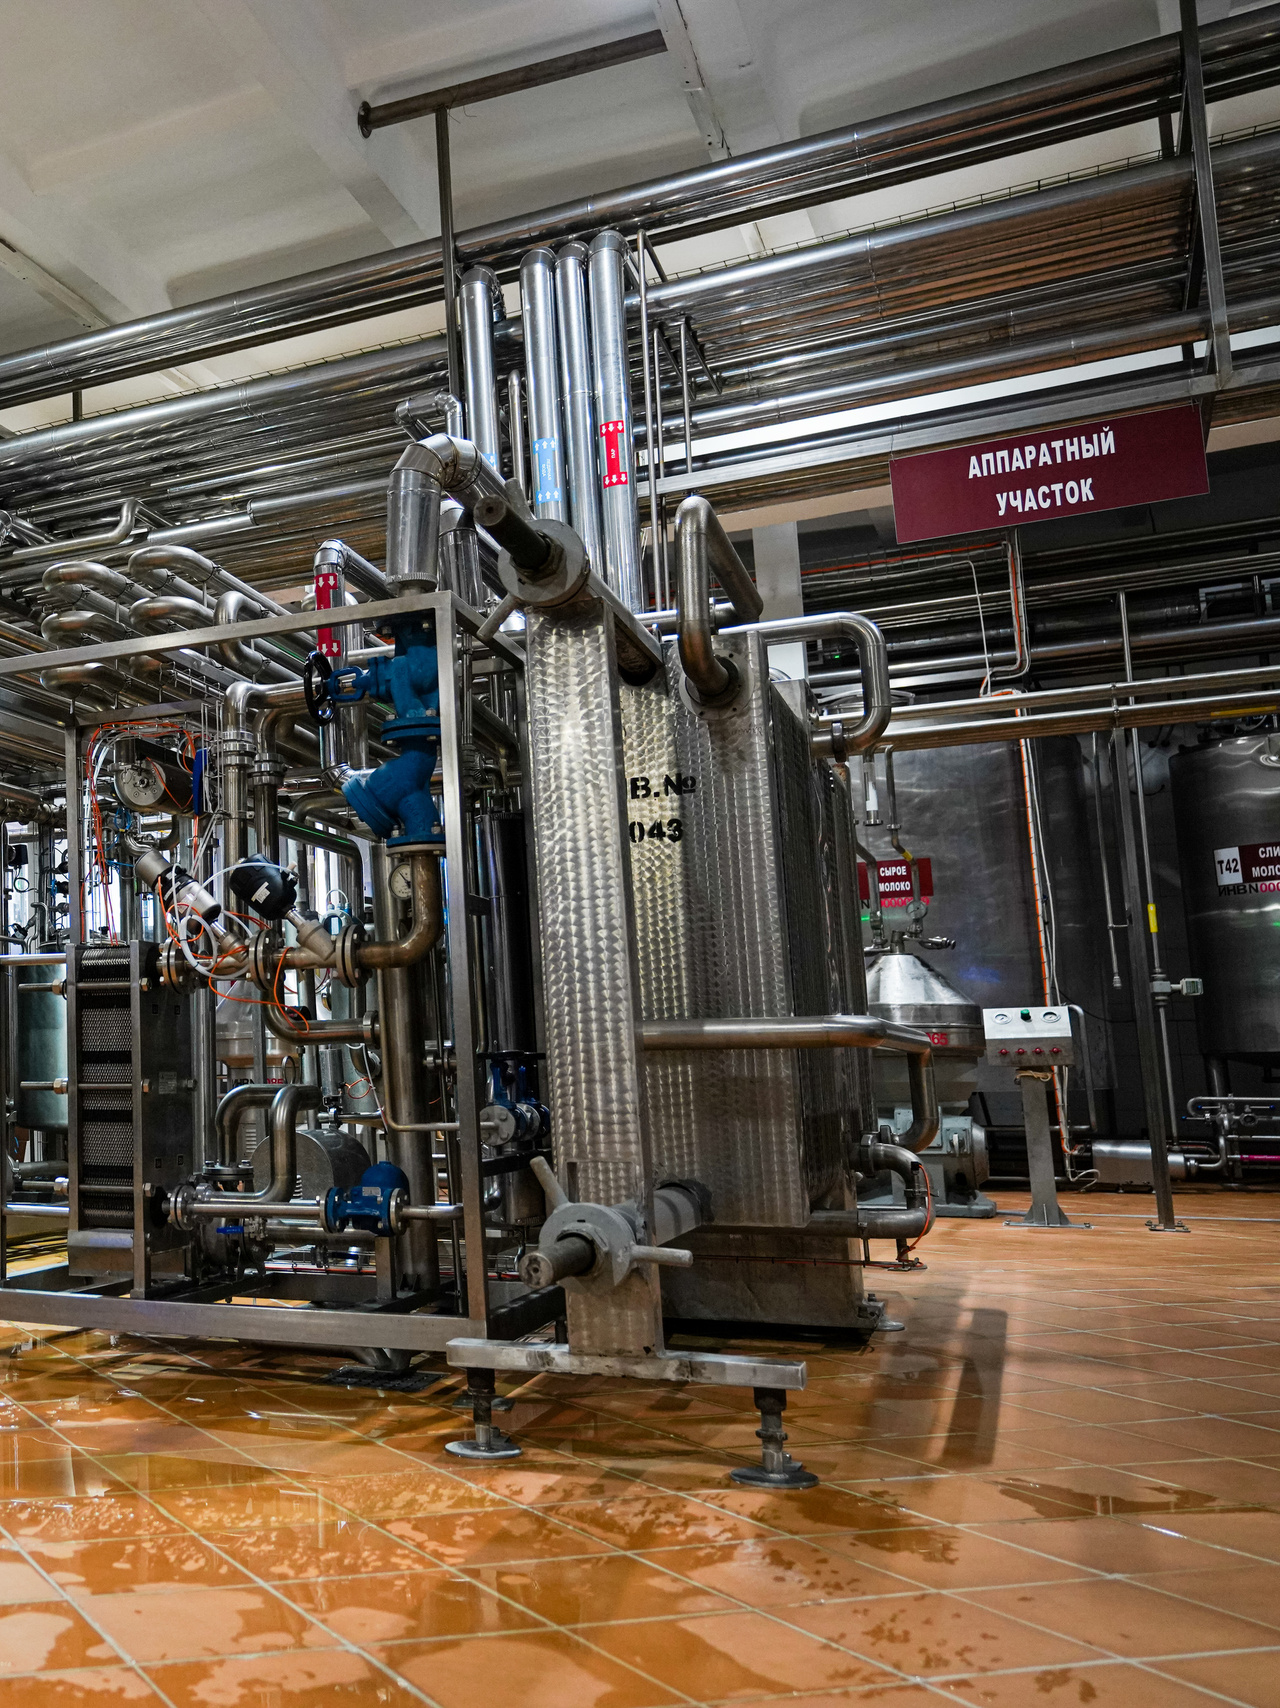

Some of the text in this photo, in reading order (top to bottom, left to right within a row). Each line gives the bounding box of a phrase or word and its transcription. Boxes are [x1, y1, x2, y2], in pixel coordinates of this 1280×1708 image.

[968, 426, 1116, 479] АППАРАТНЫЙ
[996, 477, 1095, 516] УЧАСТОК
[629, 818, 683, 843] 043
[880, 866, 907, 877] СЫРОЕ
[879, 881, 911, 892] МОЛОКО
